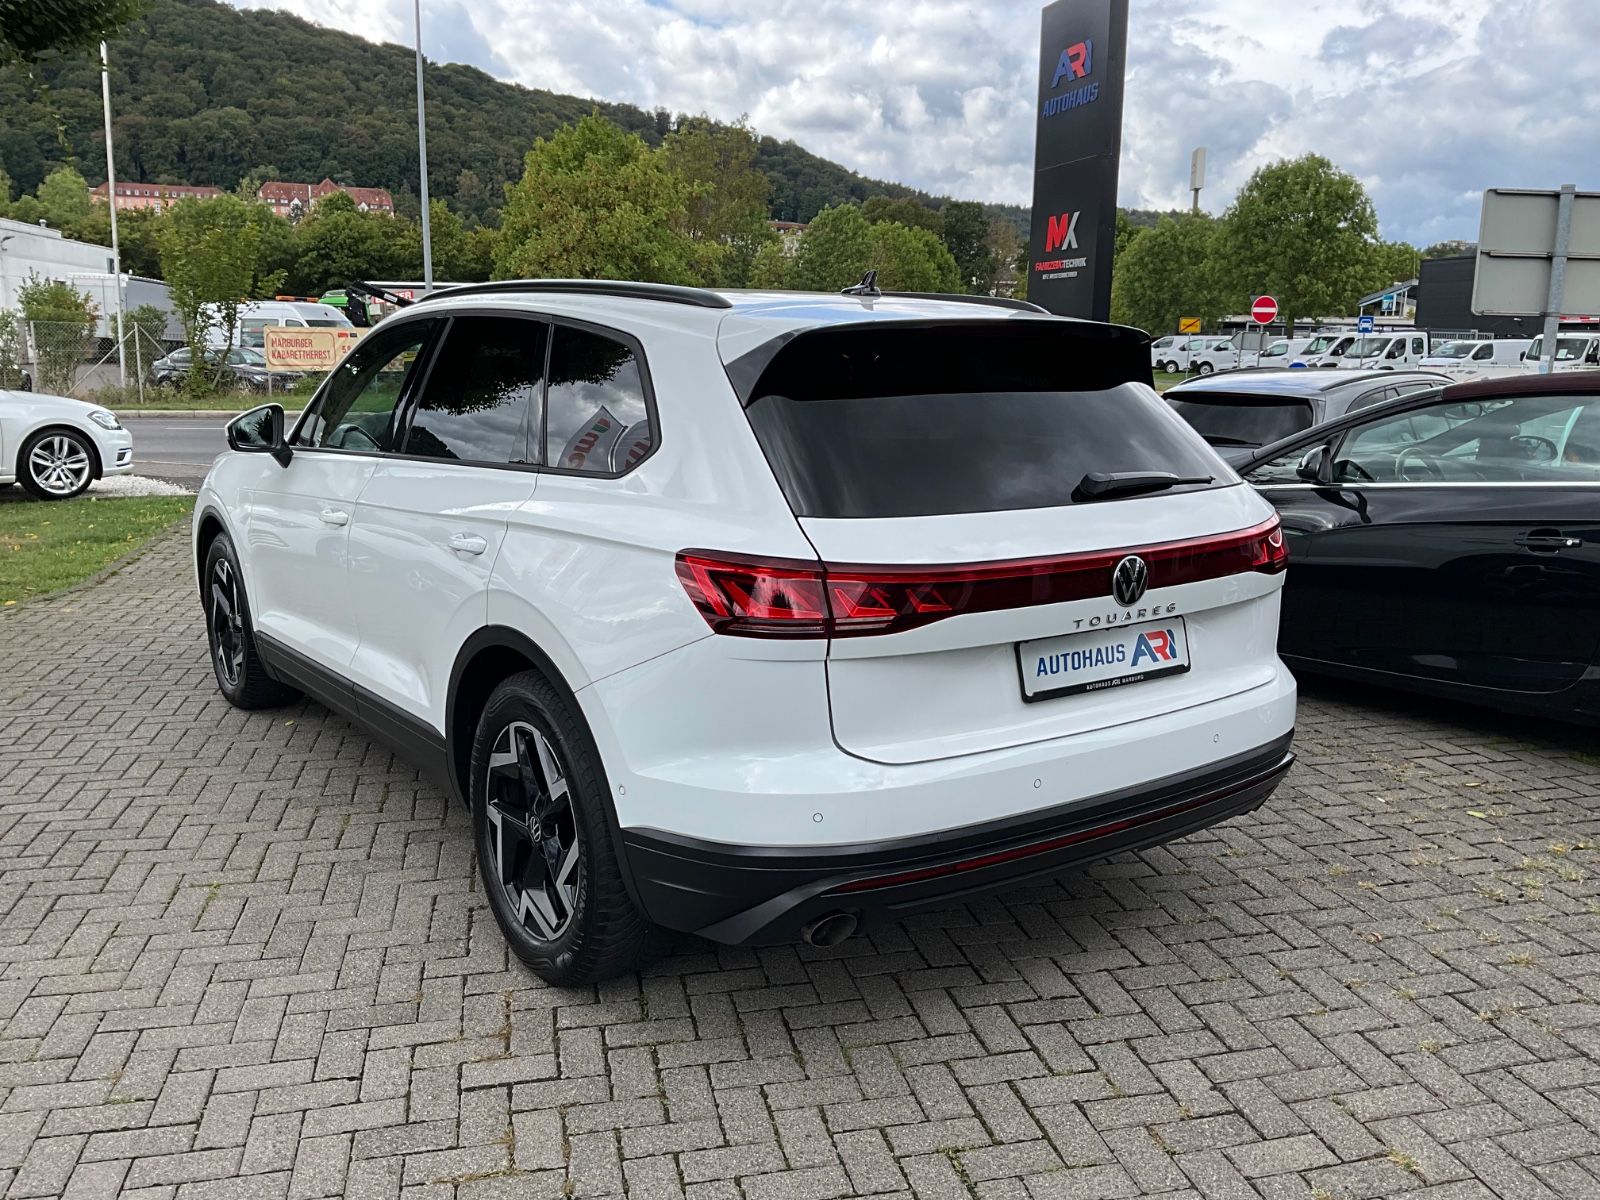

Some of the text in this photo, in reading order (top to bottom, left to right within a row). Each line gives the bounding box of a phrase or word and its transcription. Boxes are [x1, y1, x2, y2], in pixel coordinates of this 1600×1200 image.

[1042, 82, 1099, 118] AUTOHAUS
[271, 338, 313, 348] MARBURGER
[271, 349, 331, 360] KABARETTHERBST
[1073, 602, 1177, 630] TOUAREG
[1036, 628, 1178, 677] AUTOHAUS ARI
[1086, 680, 1111, 690] AUTOHAUS
